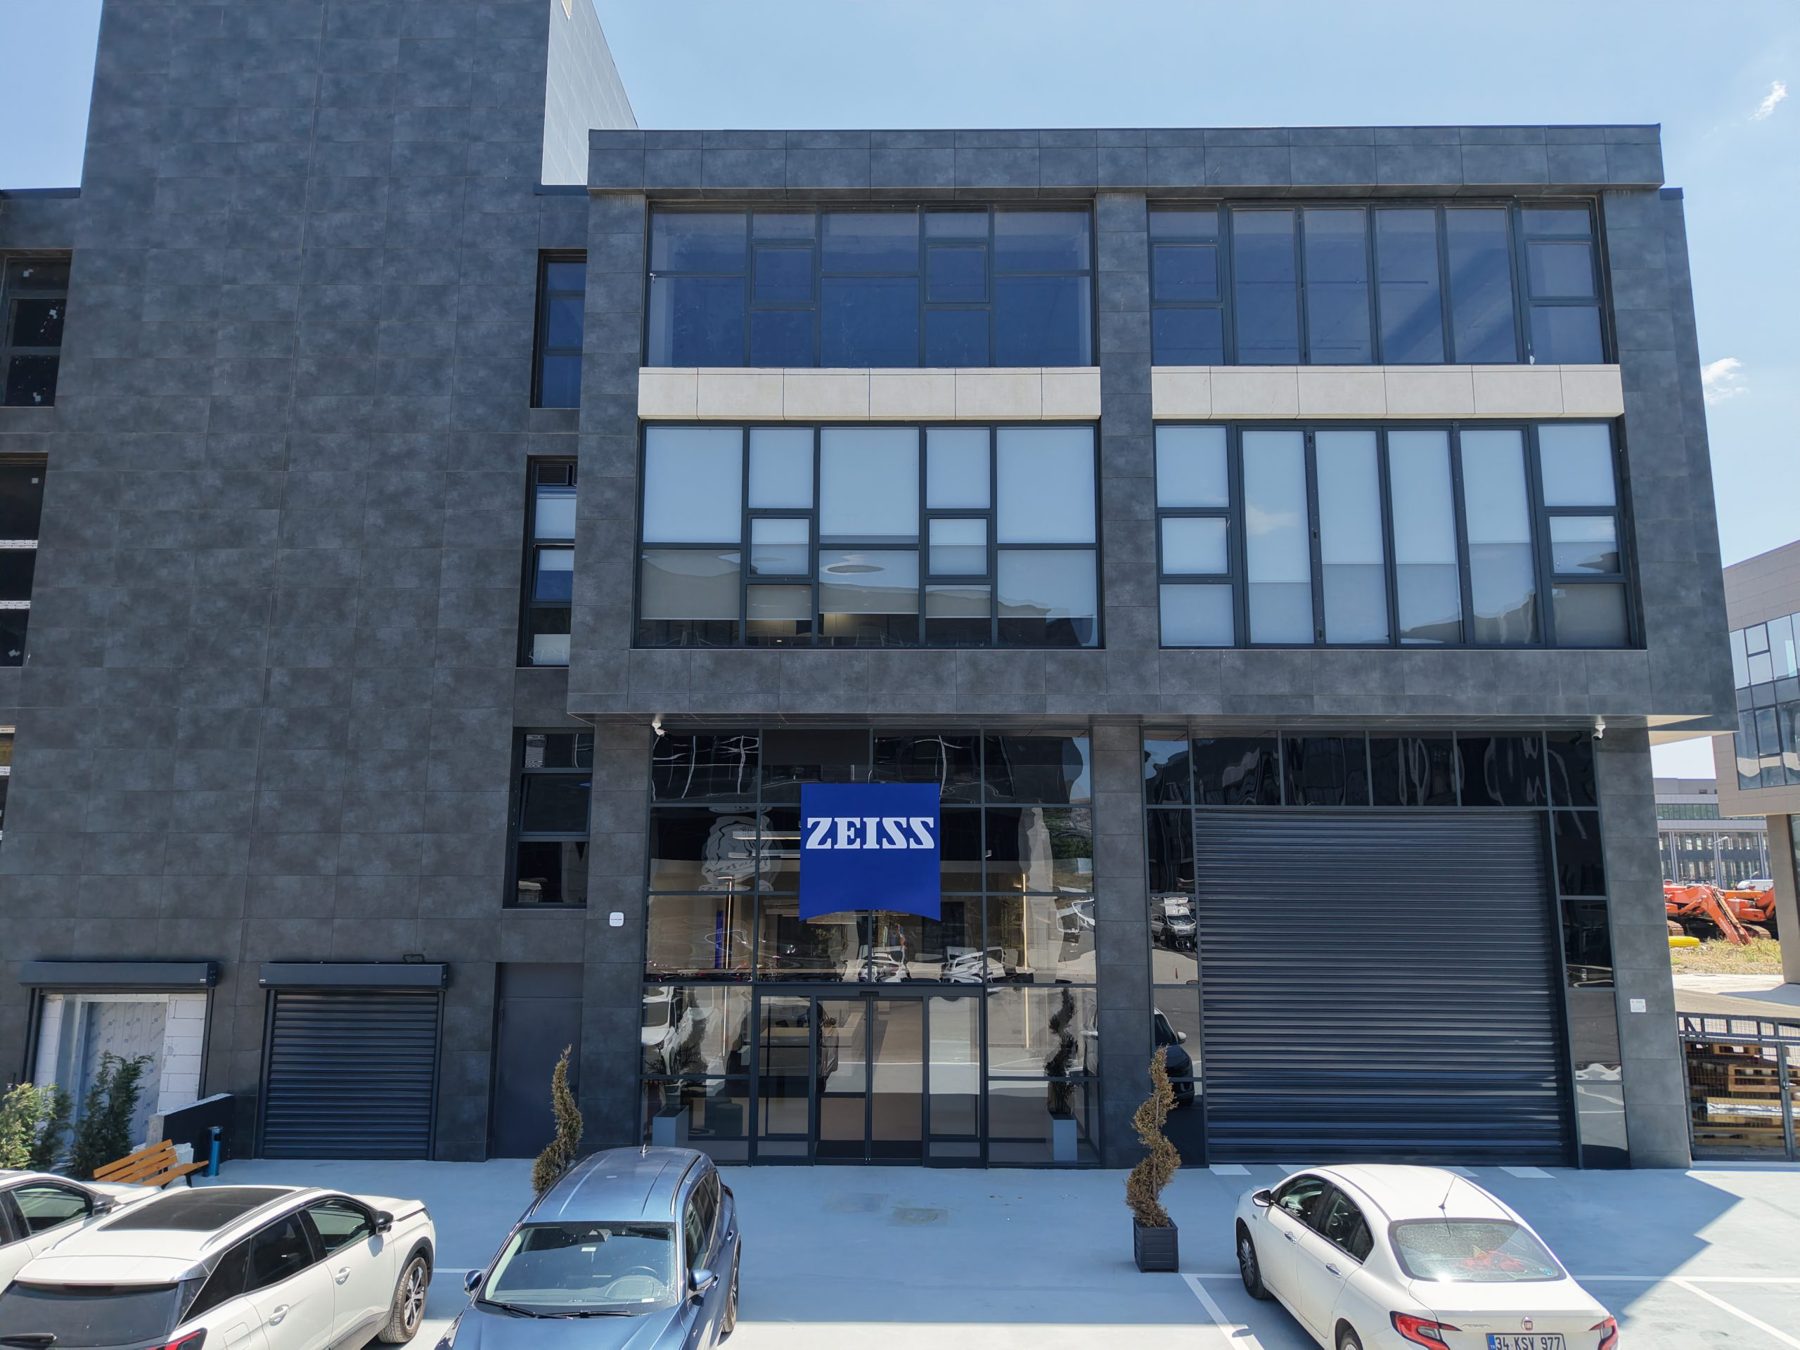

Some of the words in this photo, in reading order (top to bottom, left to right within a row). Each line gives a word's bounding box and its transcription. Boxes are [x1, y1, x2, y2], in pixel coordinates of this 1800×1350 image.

[805, 817, 935, 849] ZEISS
[1495, 1336, 1509, 1350] 34
[1540, 1336, 1561, 1350] 977
